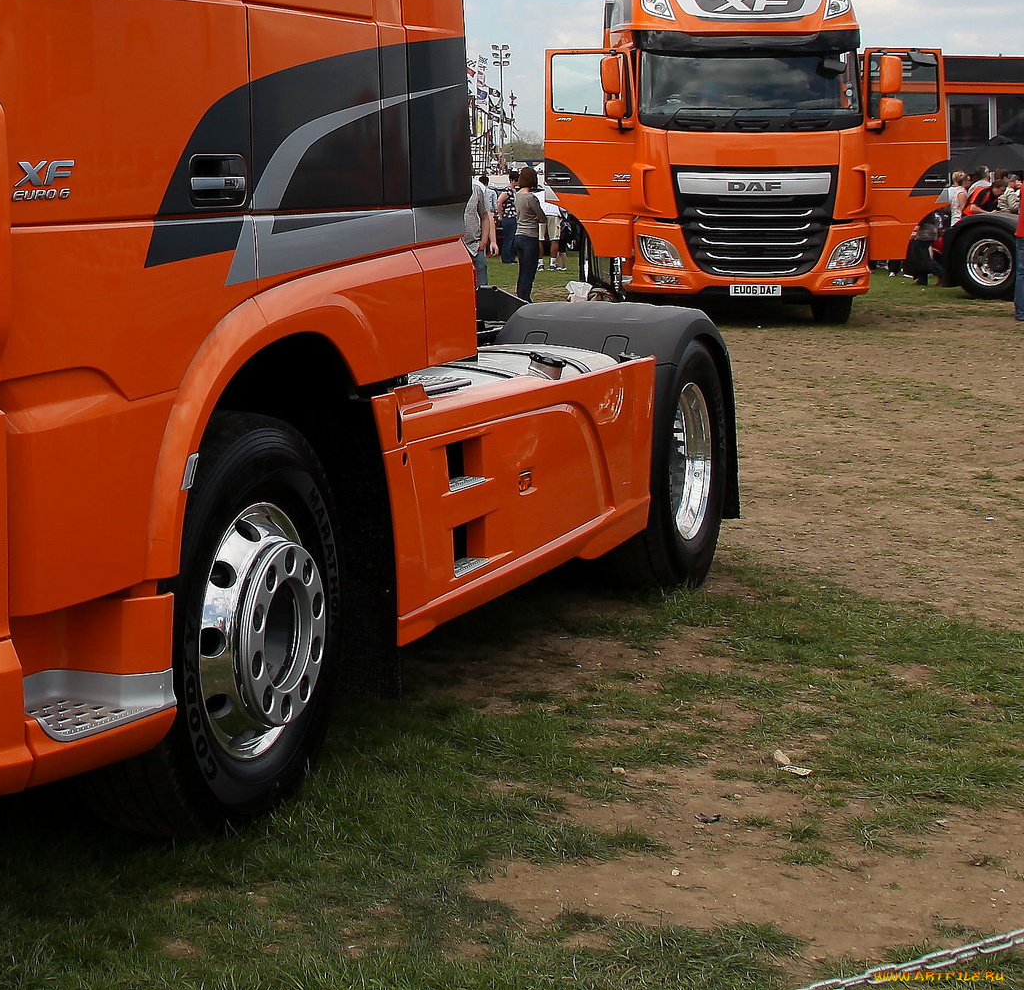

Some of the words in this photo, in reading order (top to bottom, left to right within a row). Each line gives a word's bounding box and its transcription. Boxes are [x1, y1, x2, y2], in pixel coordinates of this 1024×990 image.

[14, 160, 75, 187] XF
[728, 182, 782, 192] DAF
[733, 285, 758, 295] EU06
[759, 285, 778, 295] DAF
